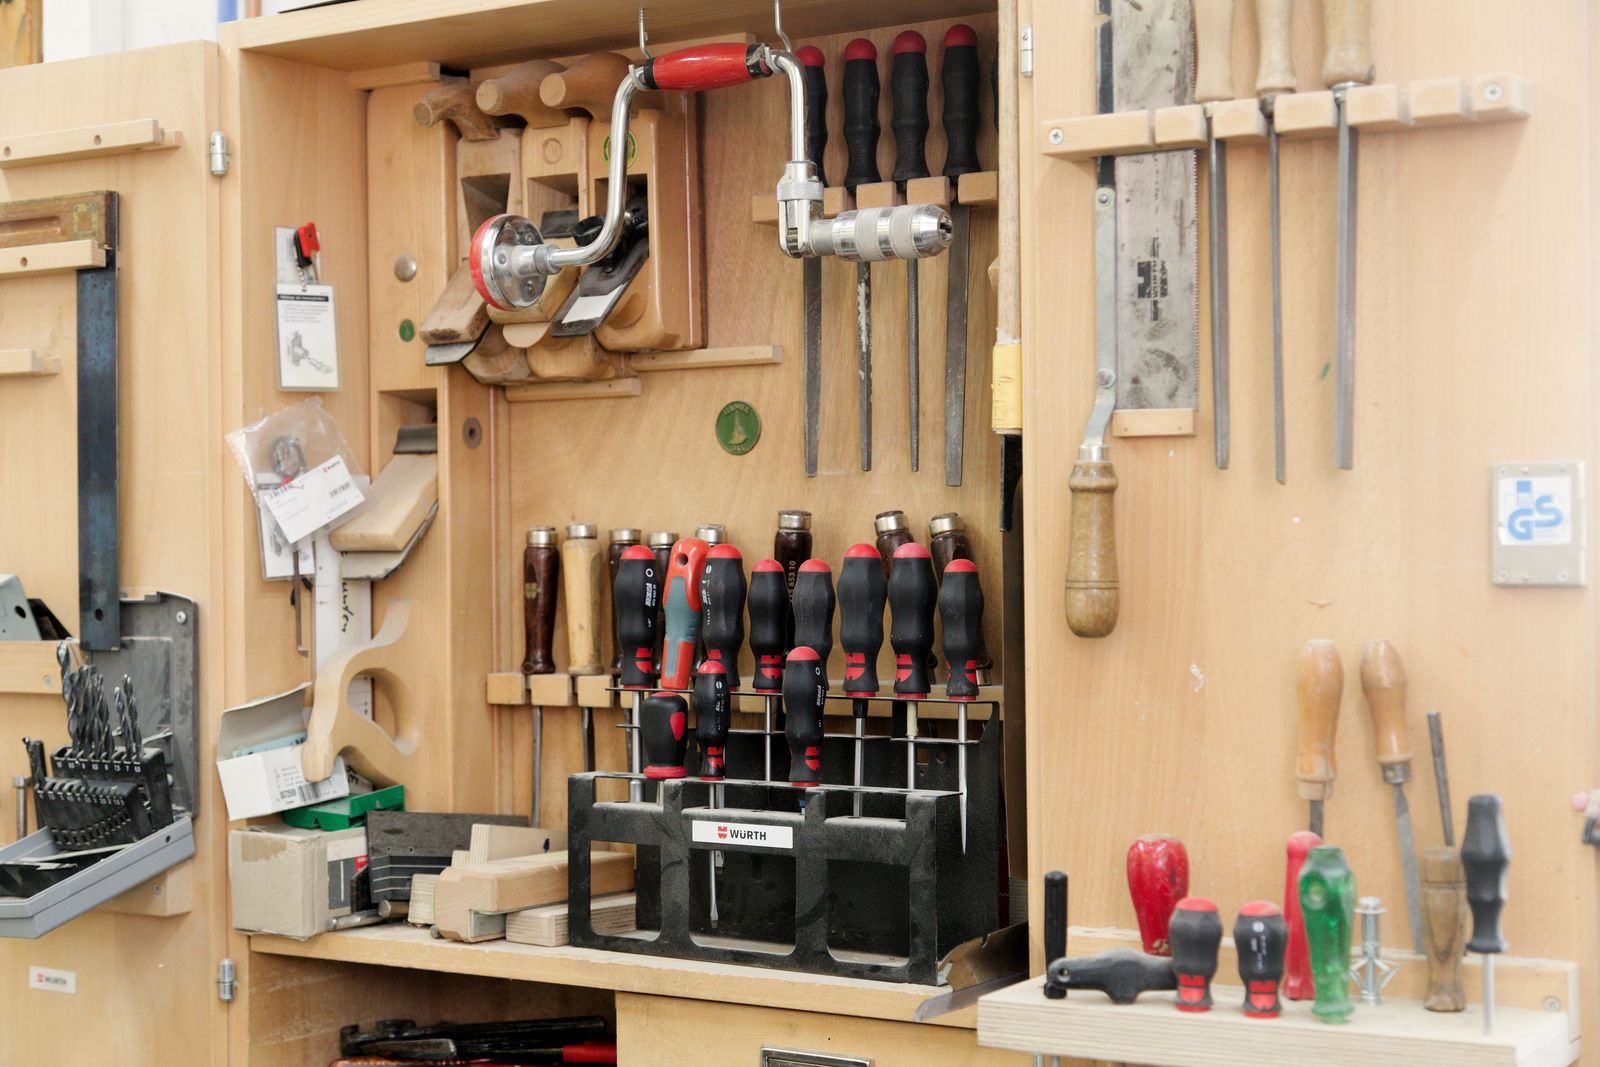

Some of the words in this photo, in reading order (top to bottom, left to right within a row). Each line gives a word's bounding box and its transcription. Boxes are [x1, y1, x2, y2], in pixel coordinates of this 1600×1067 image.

[1508, 495, 1563, 540] GS
[788, 572, 796, 587] 653
[729, 829, 767, 841] WÜRTH
